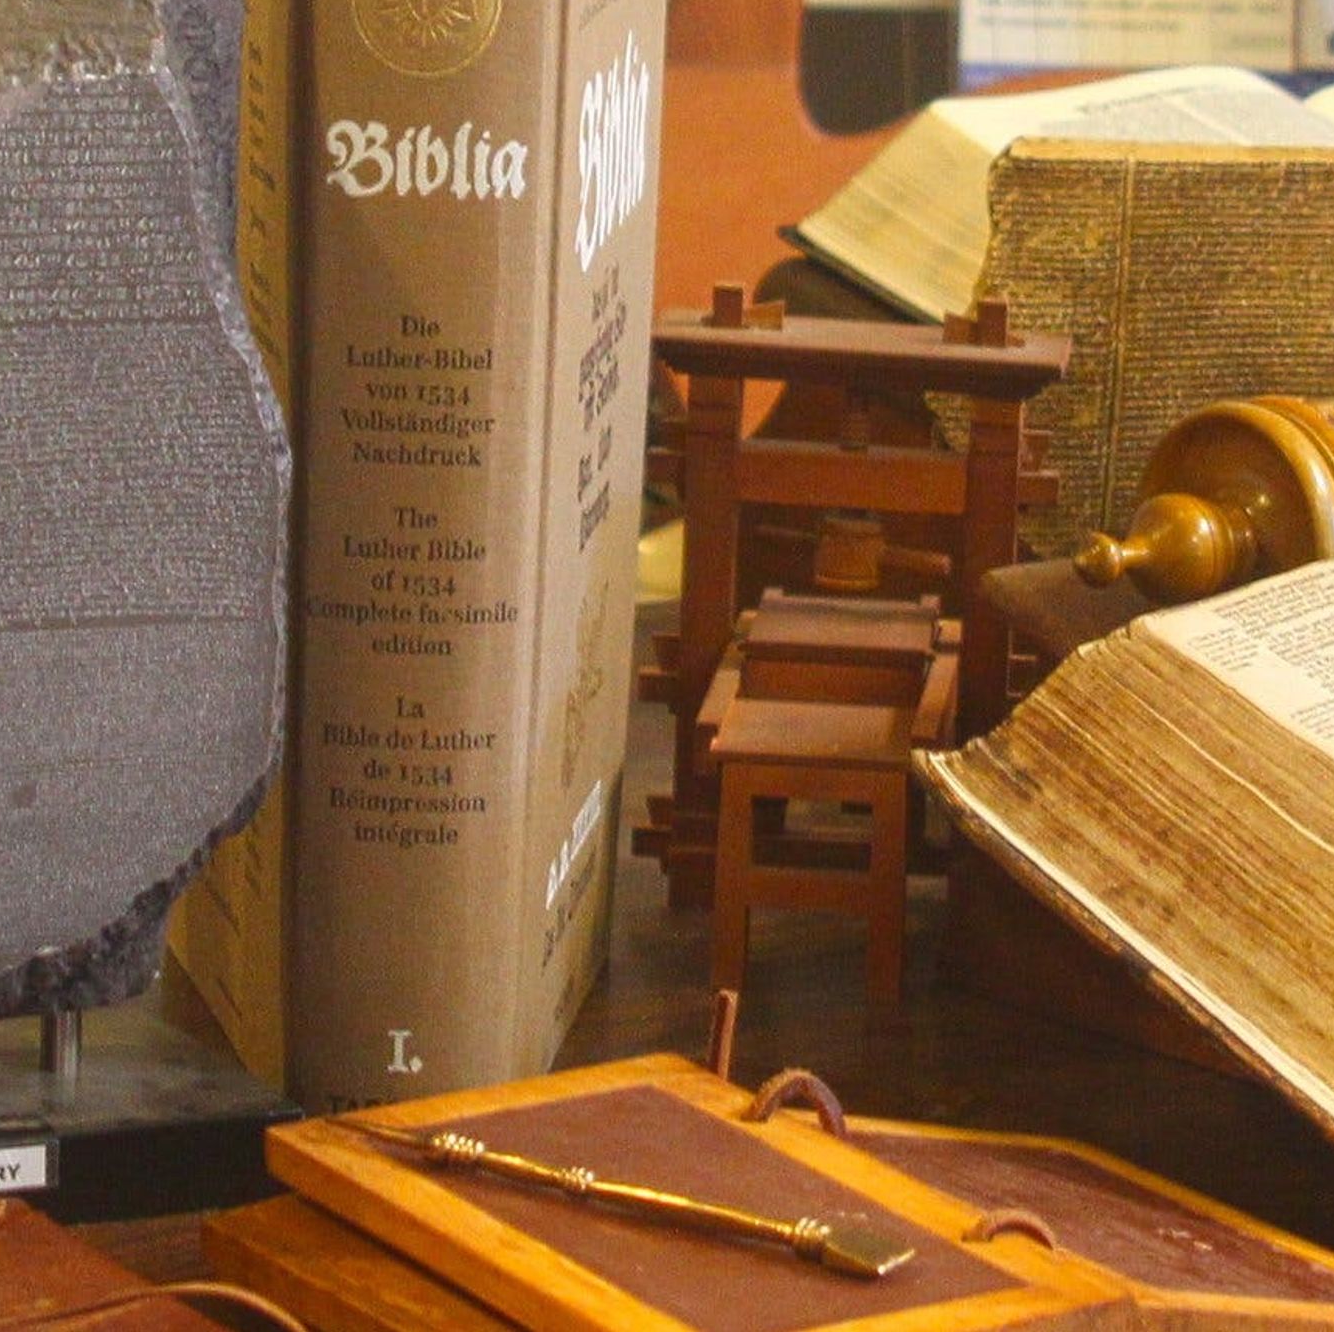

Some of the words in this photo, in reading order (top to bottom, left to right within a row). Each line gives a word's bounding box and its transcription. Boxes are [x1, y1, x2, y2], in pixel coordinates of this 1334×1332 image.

[324, 118, 530, 202] Biblia
[574, 29, 650, 273] Biblia
[401, 314, 441, 339] Die
[345, 344, 494, 370] Luther-Bibel
[366, 381, 409, 402] von
[417, 381, 471, 407] 1534
[340, 408, 496, 440] Vollständiger
[352, 441, 482, 468] Nachdruck
[394, 506, 439, 530] The
[343, 534, 422, 563] Luther
[427, 538, 487, 563] Bible
[370, 568, 397, 592] of
[402, 572, 457, 598] 1534
[305, 597, 413, 627] Complete
[419, 599, 519, 626] facsimile
[371, 633, 453, 657] edition
[396, 696, 426, 719] La
[323, 720, 381, 748] Bible
[385, 728, 415, 751] de
[420, 728, 497, 752] Luther
[363, 758, 391, 782] de
[398, 761, 454, 788] 1534
[329, 786, 487, 816] Réimpression
[354, 823, 460, 850] intégrale
[386, 1028, 424, 1074] I.
